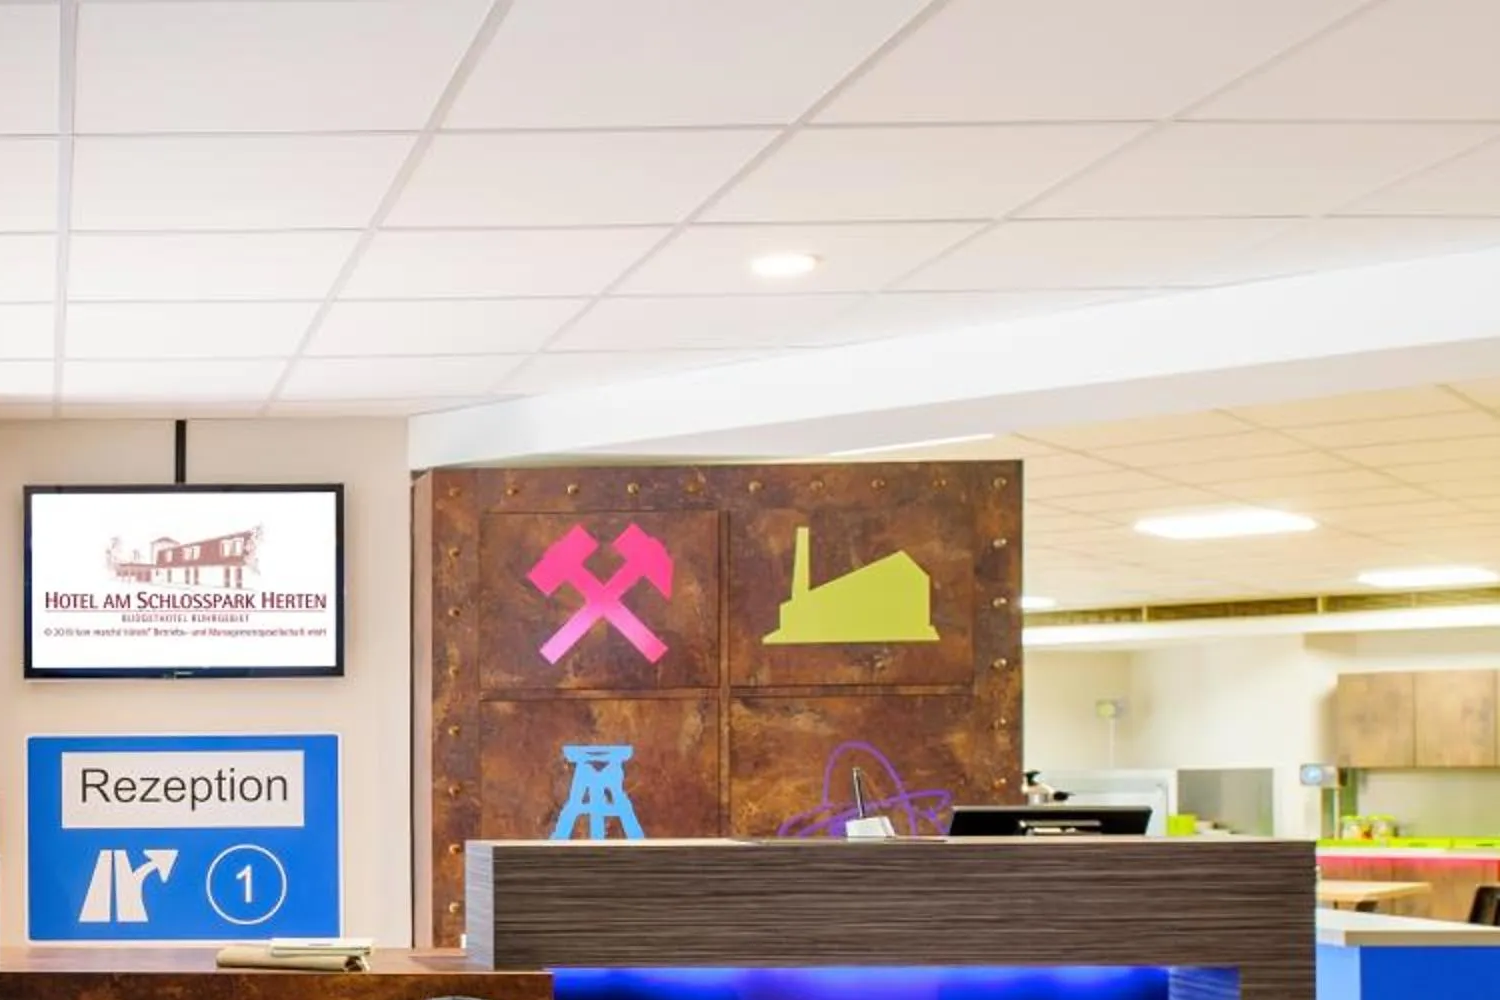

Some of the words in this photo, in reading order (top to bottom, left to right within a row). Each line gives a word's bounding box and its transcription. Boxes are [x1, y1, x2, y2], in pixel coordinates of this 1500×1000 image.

[45, 592, 98, 609] HOTEL
[103, 593, 131, 609] AM
[137, 591, 256, 609] SCHLOSSPARK
[261, 591, 327, 609] HERTEN
[80, 767, 288, 811] Rezeption
[235, 864, 254, 905] 1
